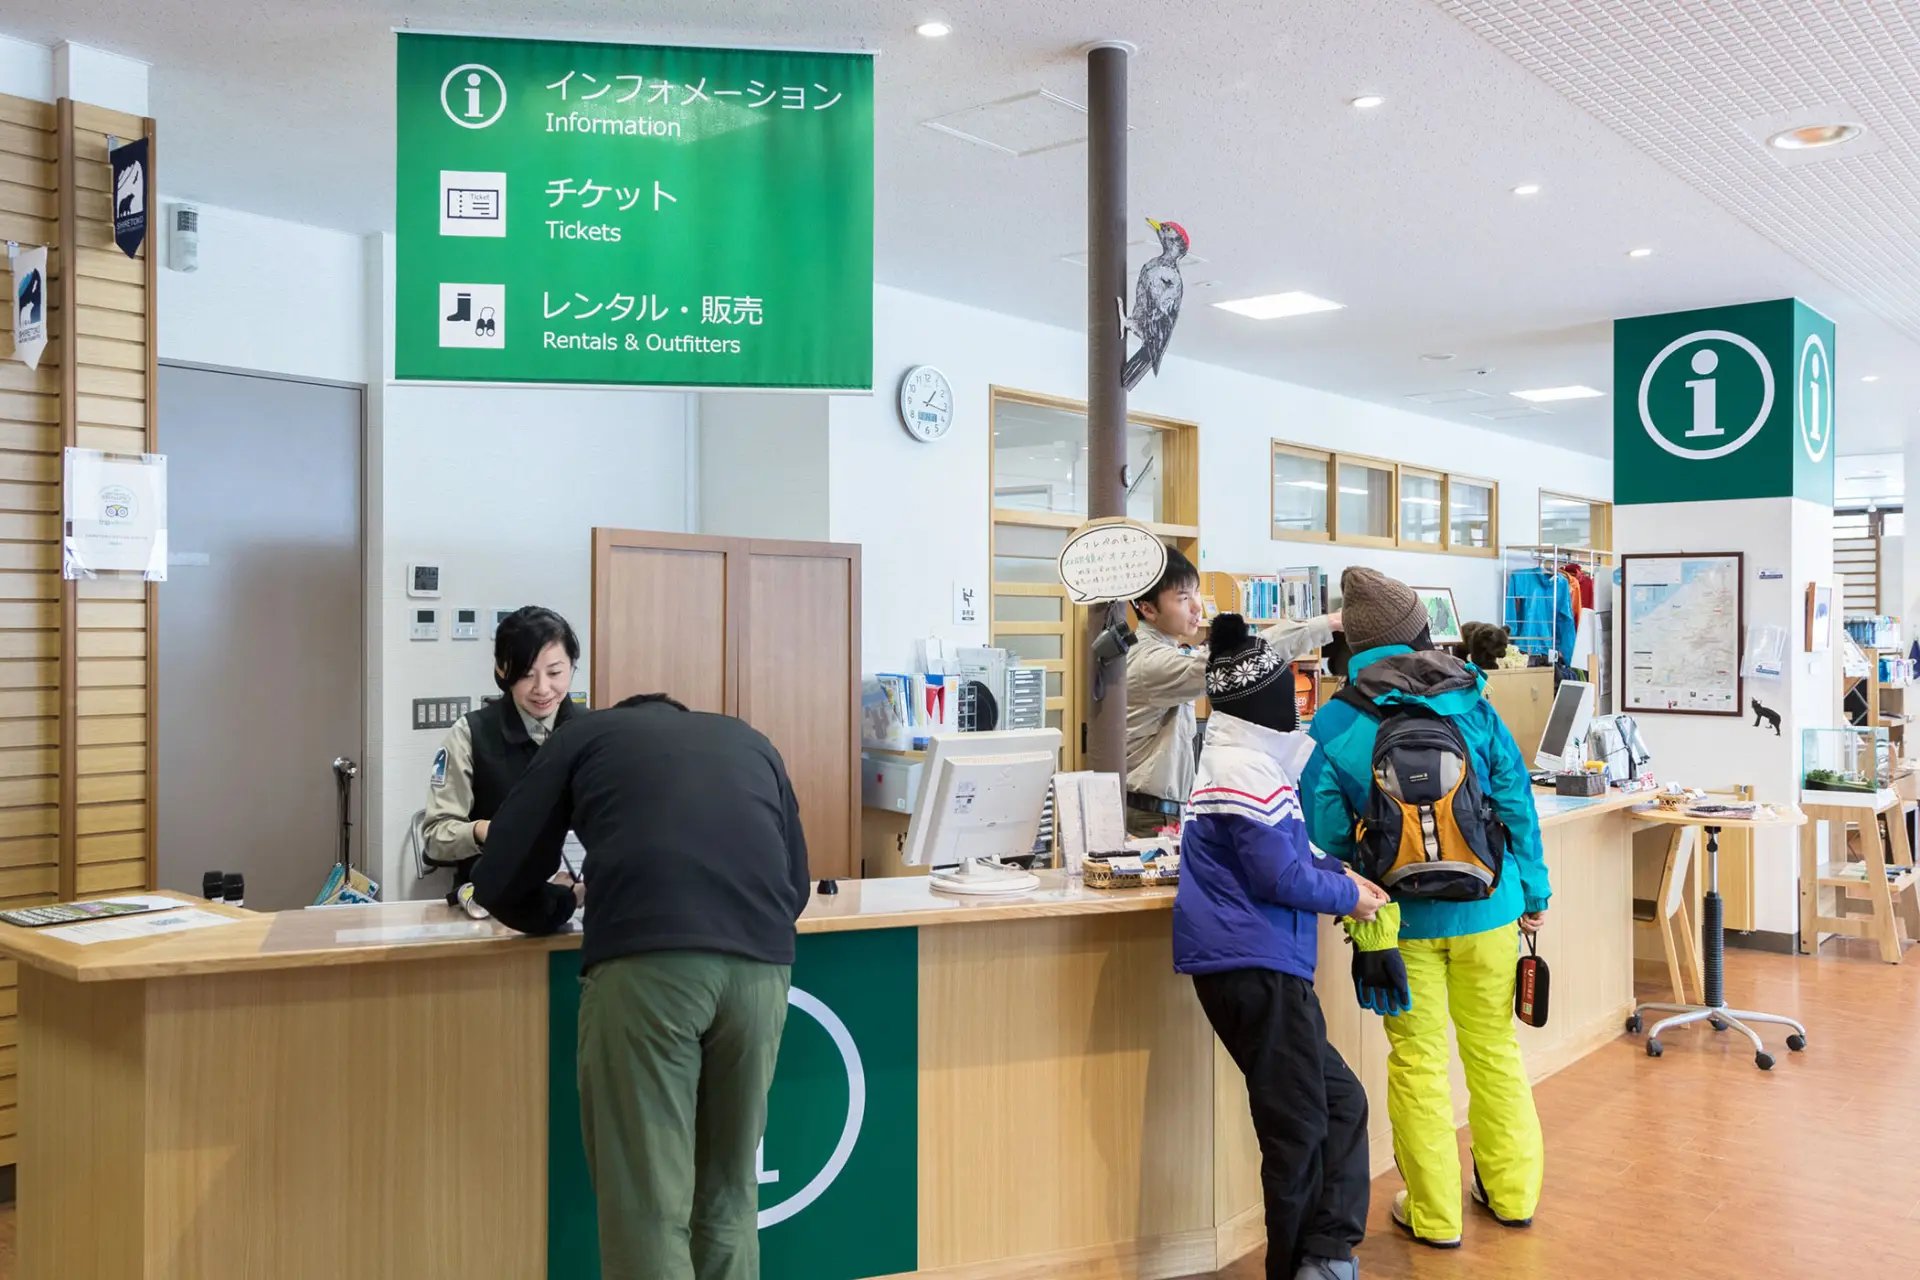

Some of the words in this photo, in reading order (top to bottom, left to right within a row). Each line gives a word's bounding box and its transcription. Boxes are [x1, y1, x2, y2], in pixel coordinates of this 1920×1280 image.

[546, 71, 842, 111] インフォメーション
[546, 112, 681, 137] Information
[545, 178, 677, 211] チケット
[546, 221, 622, 242] Tickets
[544, 291, 763, 326] レンタル・販売
[544, 331, 618, 352] Rentals
[624, 333, 640, 352] &
[647, 334, 741, 354] Outfitters
